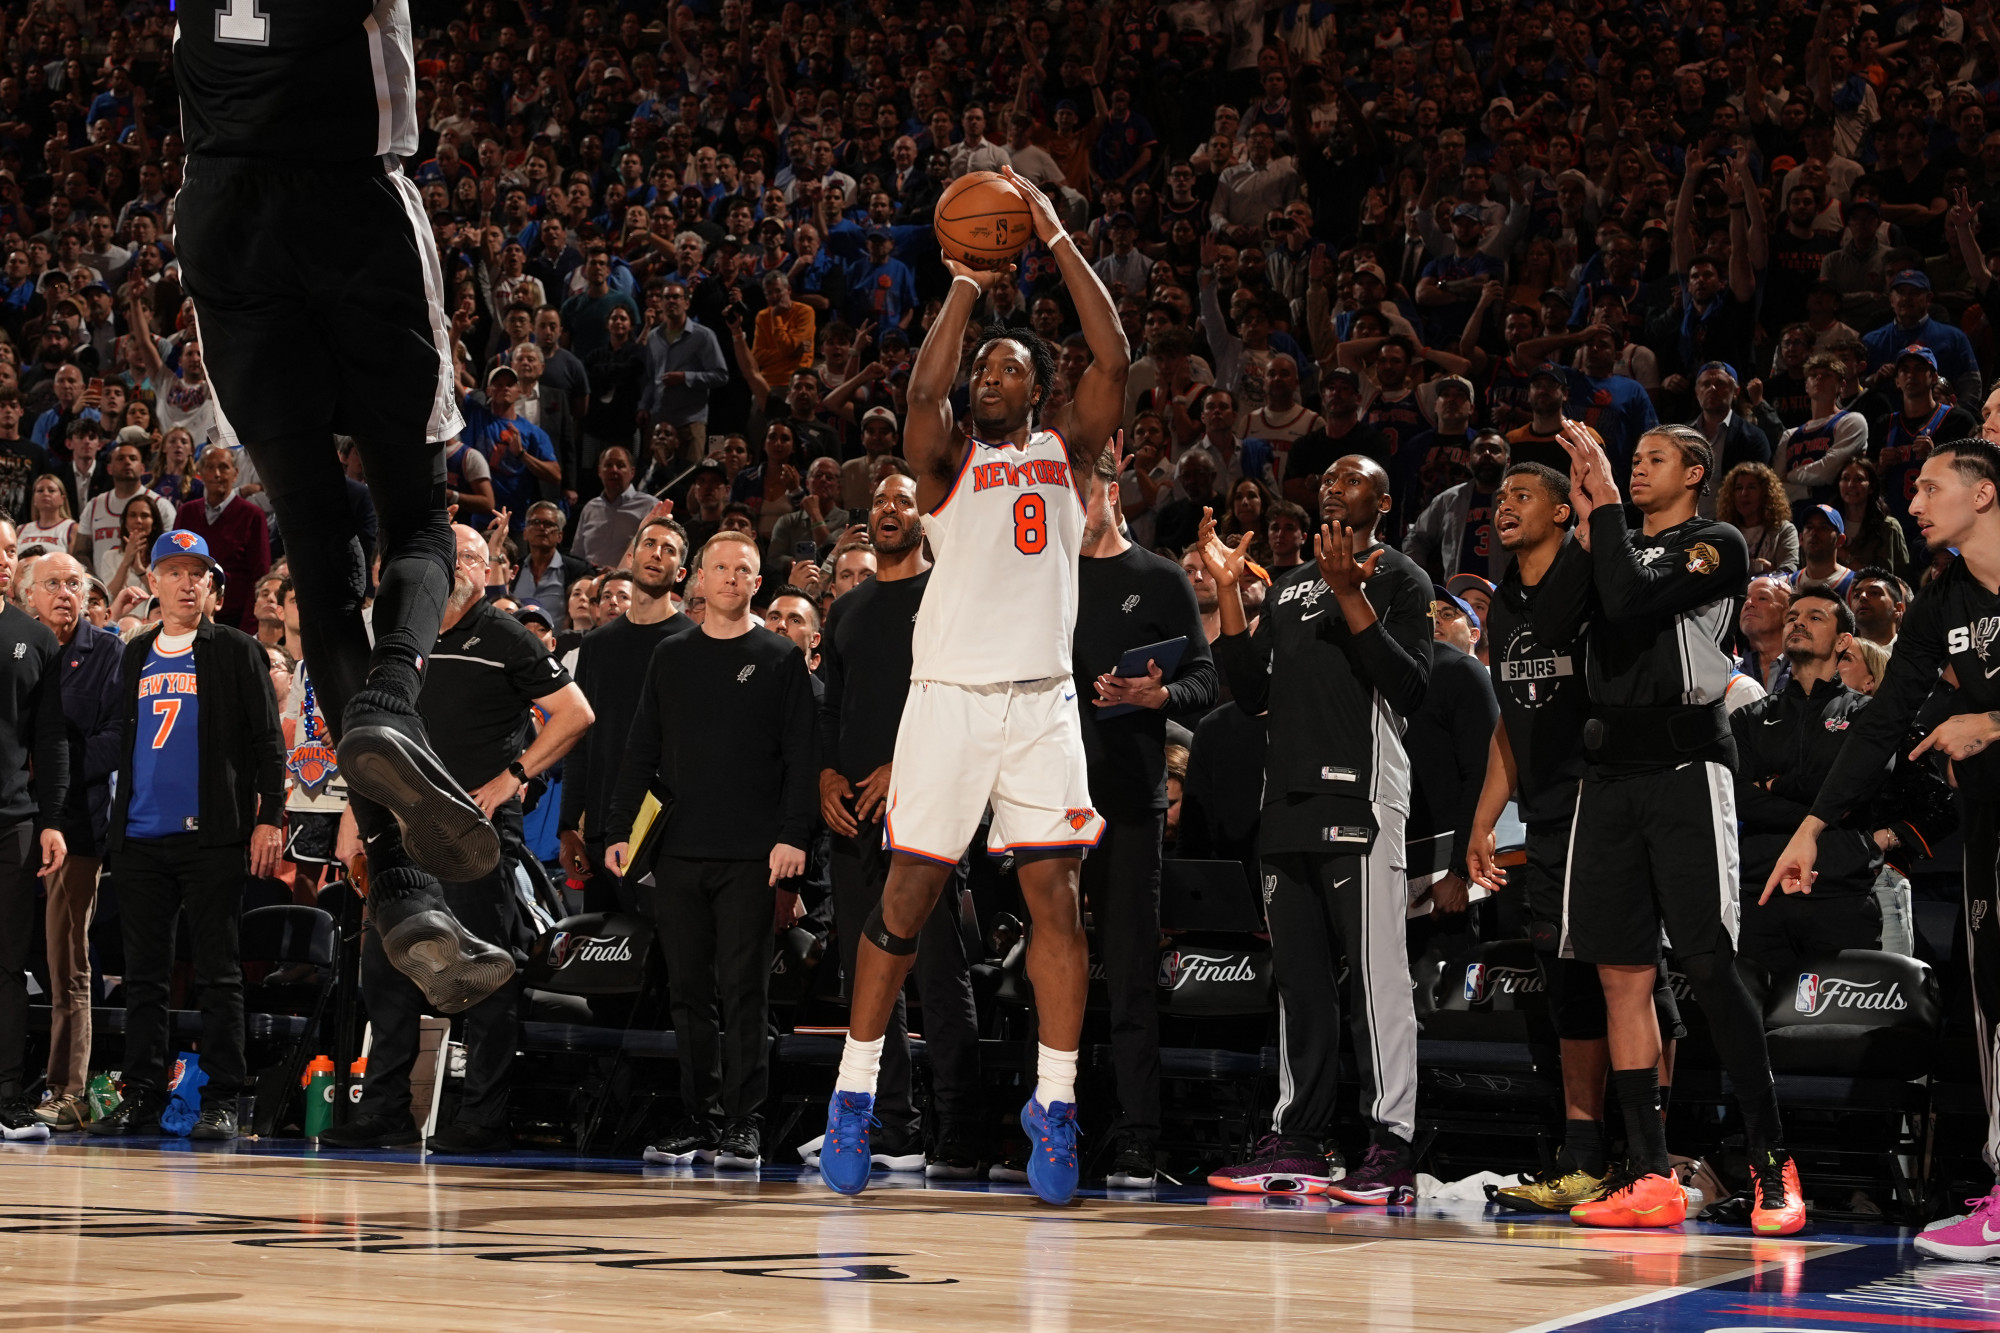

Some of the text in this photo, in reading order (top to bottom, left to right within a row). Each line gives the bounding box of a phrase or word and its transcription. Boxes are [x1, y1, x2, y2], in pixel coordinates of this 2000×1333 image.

[214, 0, 270, 47] 1
[973, 459, 1069, 492] NEW YORK
[1013, 492, 1047, 555] 8
[1474, 524, 1490, 557] 3
[139, 672, 198, 699] EW YOR
[1509, 660, 1556, 679] SPURS
[152, 699, 181, 749] 7
[288, 746, 338, 765] KNICKS
[553, 935, 633, 970] Finals
[1164, 954, 1256, 991] Finals
[1474, 966, 1546, 1006] Fina
[1803, 978, 1908, 1017] Finals
[349, 1083, 364, 1104] G
